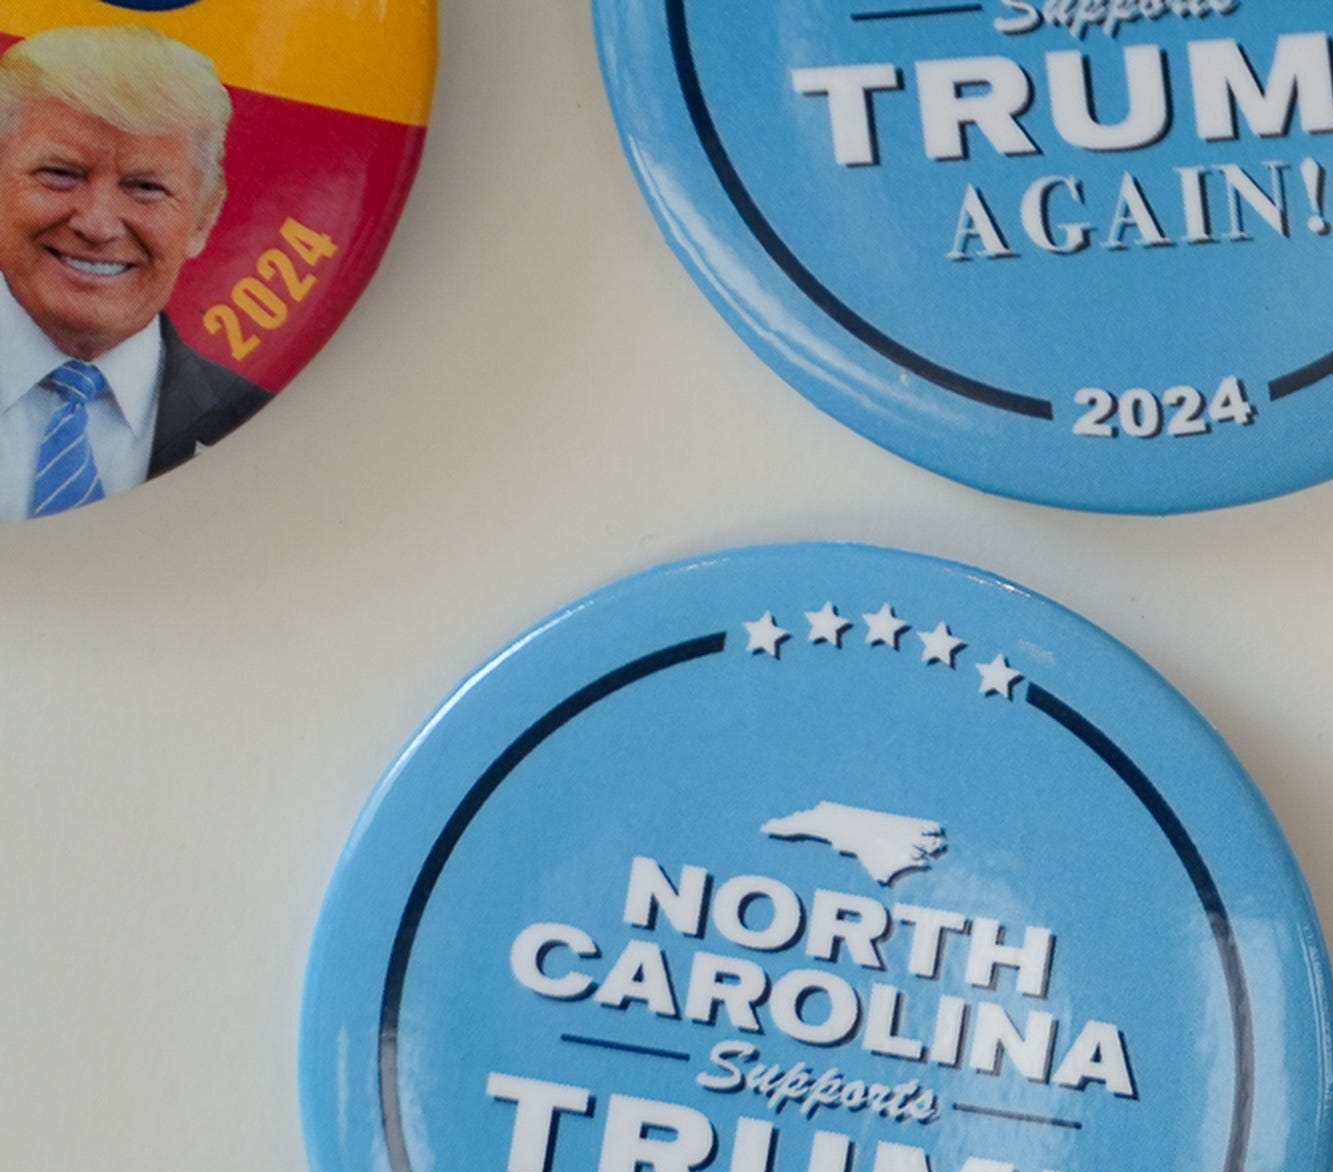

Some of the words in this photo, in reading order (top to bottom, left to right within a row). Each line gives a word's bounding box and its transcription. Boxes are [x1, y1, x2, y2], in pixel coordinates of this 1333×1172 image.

[945, 156, 1333, 262] AGAIN!
[203, 216, 338, 361] 2024
[1071, 376, 1257, 440] 2024
[621, 856, 1056, 998] NORTH
[510, 923, 1139, 1099] CAROLINA
[695, 1040, 940, 1122] Supports
